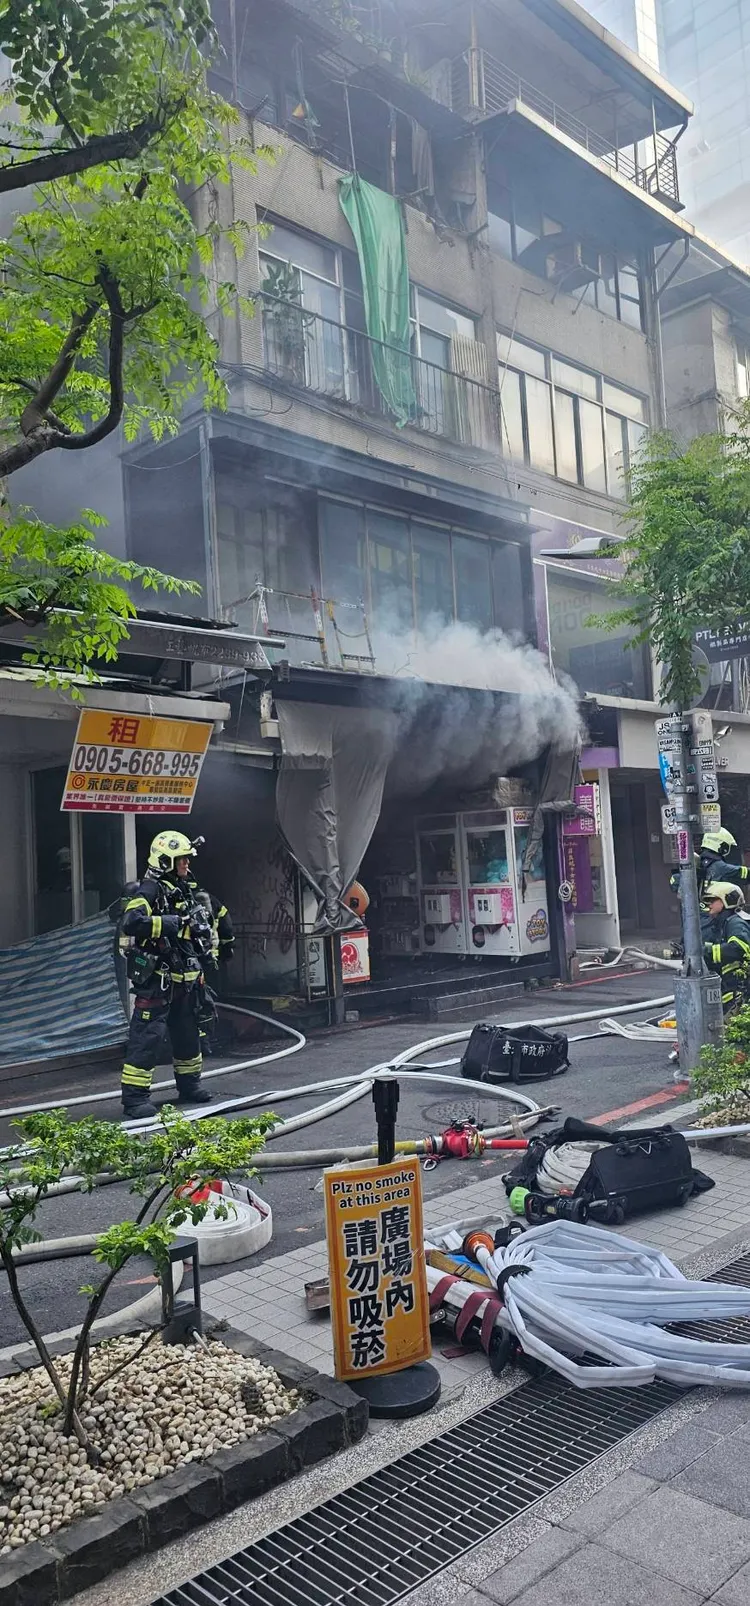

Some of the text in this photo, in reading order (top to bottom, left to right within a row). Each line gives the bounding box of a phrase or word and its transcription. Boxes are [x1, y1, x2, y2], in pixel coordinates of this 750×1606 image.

[107, 716, 140, 745] 租
[74, 746, 200, 777] 0905-668-995
[86, 778, 139, 793] 永慶房屋
[331, 1171, 415, 1195] Plz no smoke
[339, 1188, 410, 1209] at this area
[380, 1206, 414, 1319] 廣場內
[343, 1220, 386, 1368] 請勿吸菸
